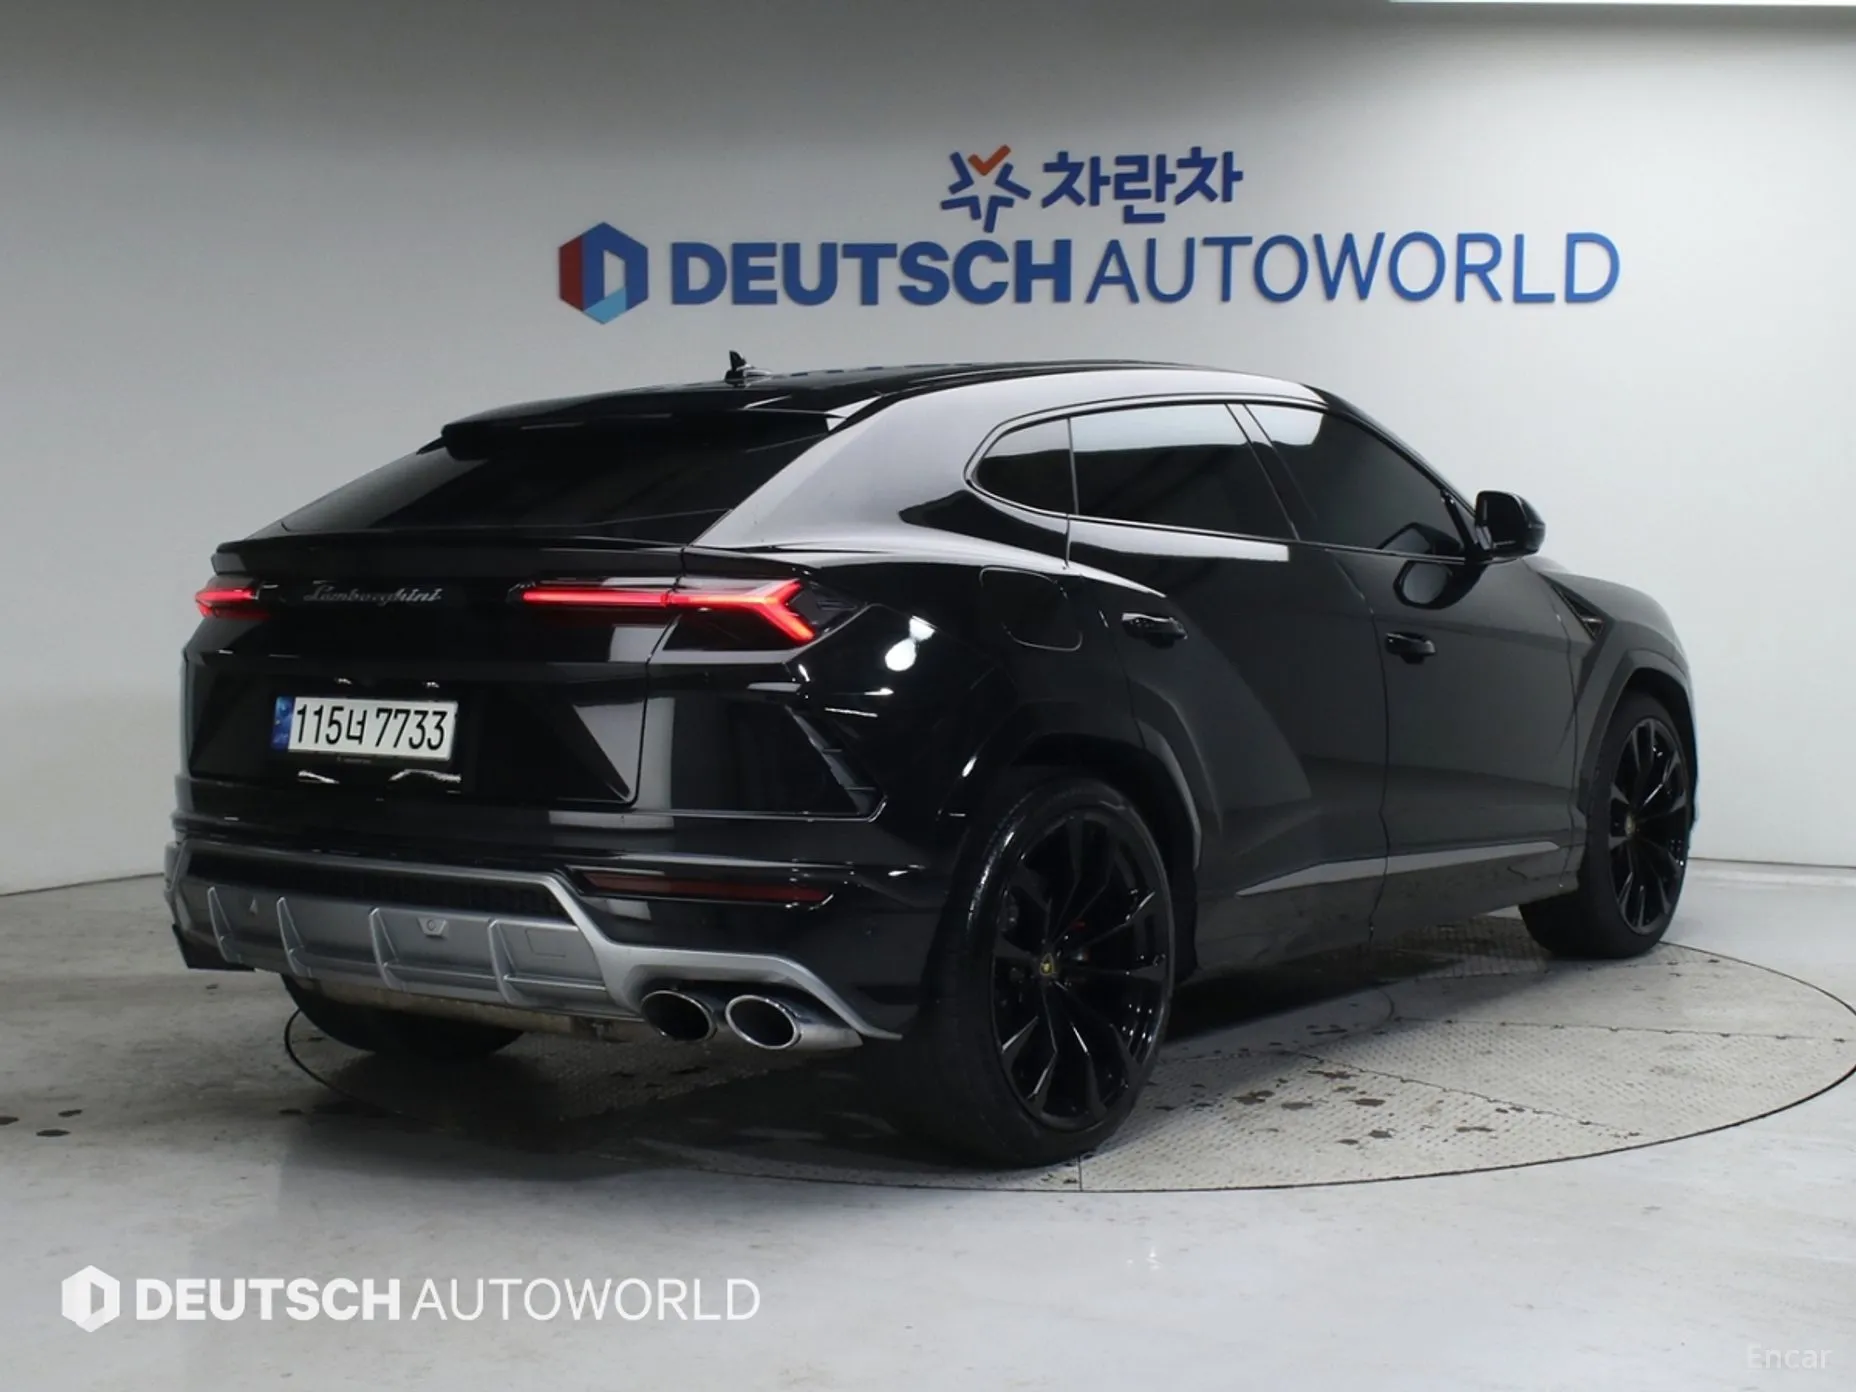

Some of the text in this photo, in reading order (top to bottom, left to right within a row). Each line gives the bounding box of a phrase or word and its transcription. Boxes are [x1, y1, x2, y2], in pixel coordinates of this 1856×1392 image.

[1042, 146, 1243, 223] 차란차
[670, 231, 1620, 305] DEUTSCH AUTOWORLD
[303, 583, 443, 606] Lamborghini
[297, 703, 448, 751] 115너 7733
